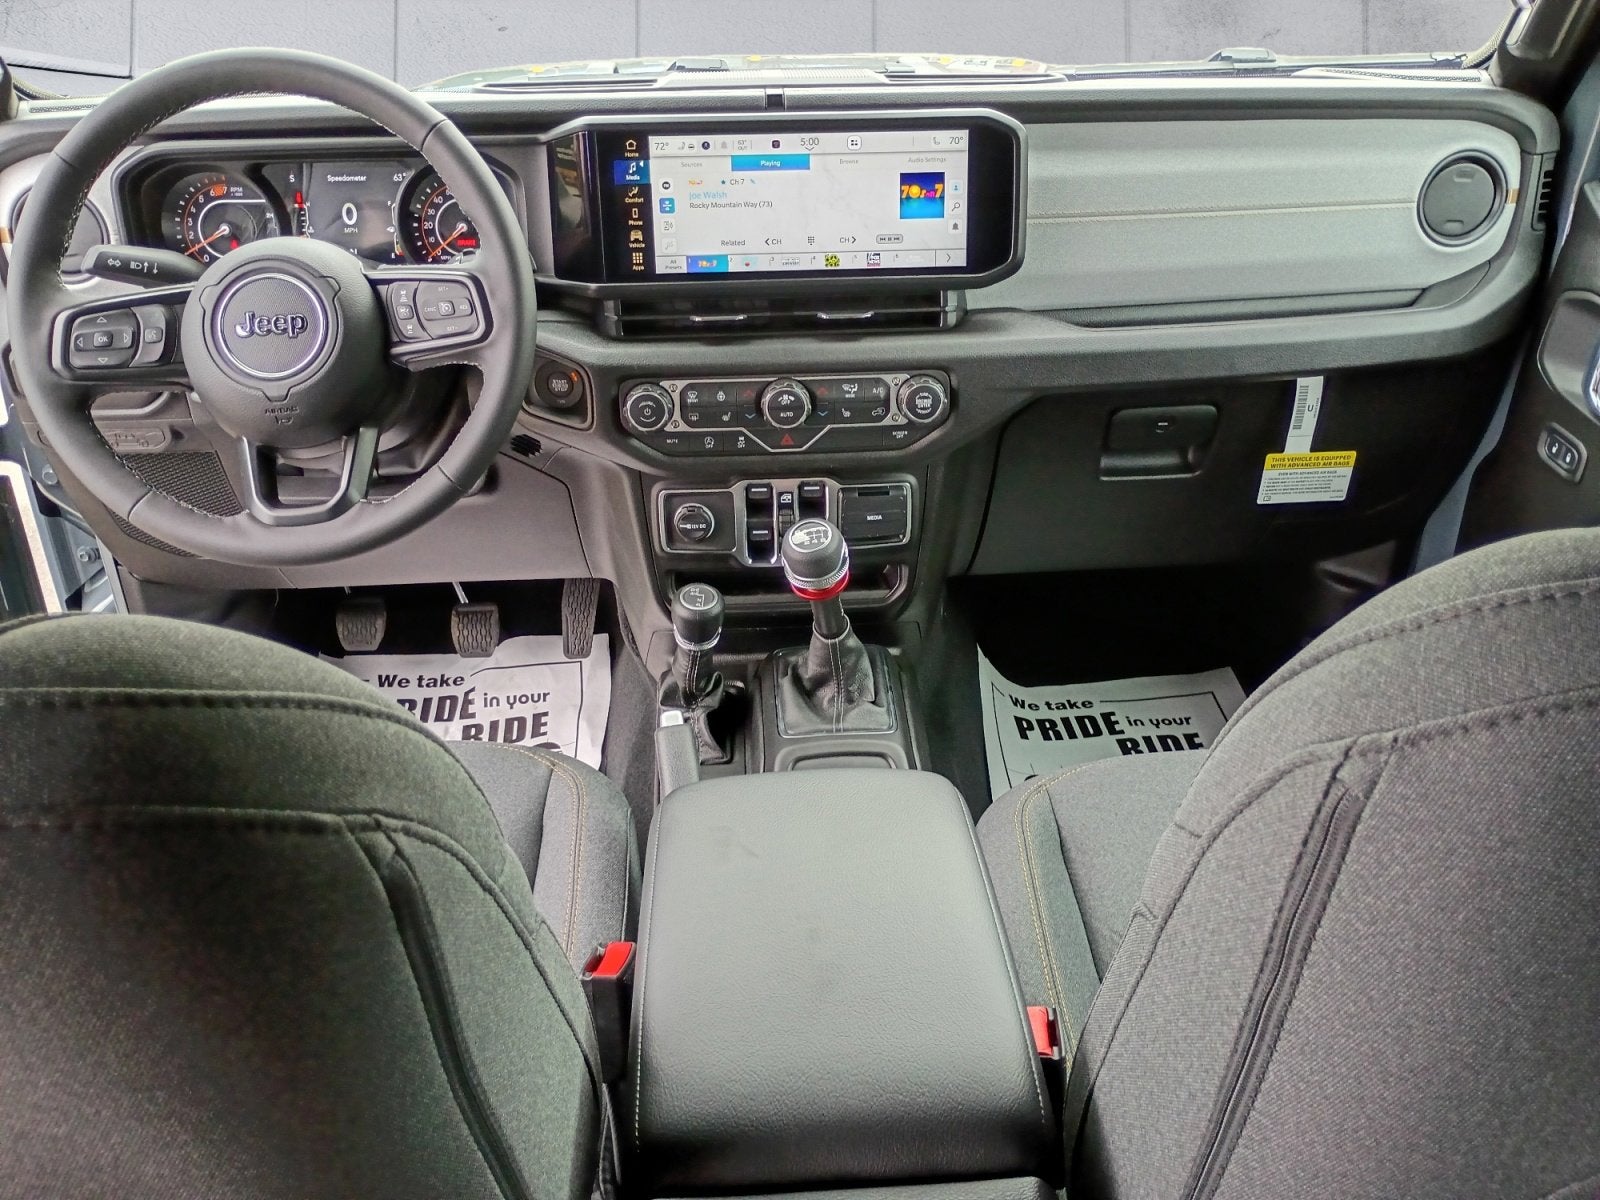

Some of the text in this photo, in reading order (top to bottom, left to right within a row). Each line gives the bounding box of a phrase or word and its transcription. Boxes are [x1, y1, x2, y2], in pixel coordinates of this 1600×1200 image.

[654, 142, 670, 150] 72°
[800, 138, 820, 146] 5:00
[949, 136, 964, 144] 70°
[689, 192, 702, 200] Joe
[342, 203, 357, 225] 0
[689, 202, 709, 210] Rocky
[236, 311, 308, 338] Jeep
[378, 674, 465, 688] We take
[397, 687, 551, 723] RIDE in your
[1009, 694, 1094, 711] We take
[462, 711, 549, 742] RIDE
[1013, 711, 1192, 742] PRIDE in your
[1116, 732, 1204, 756] RIDE
